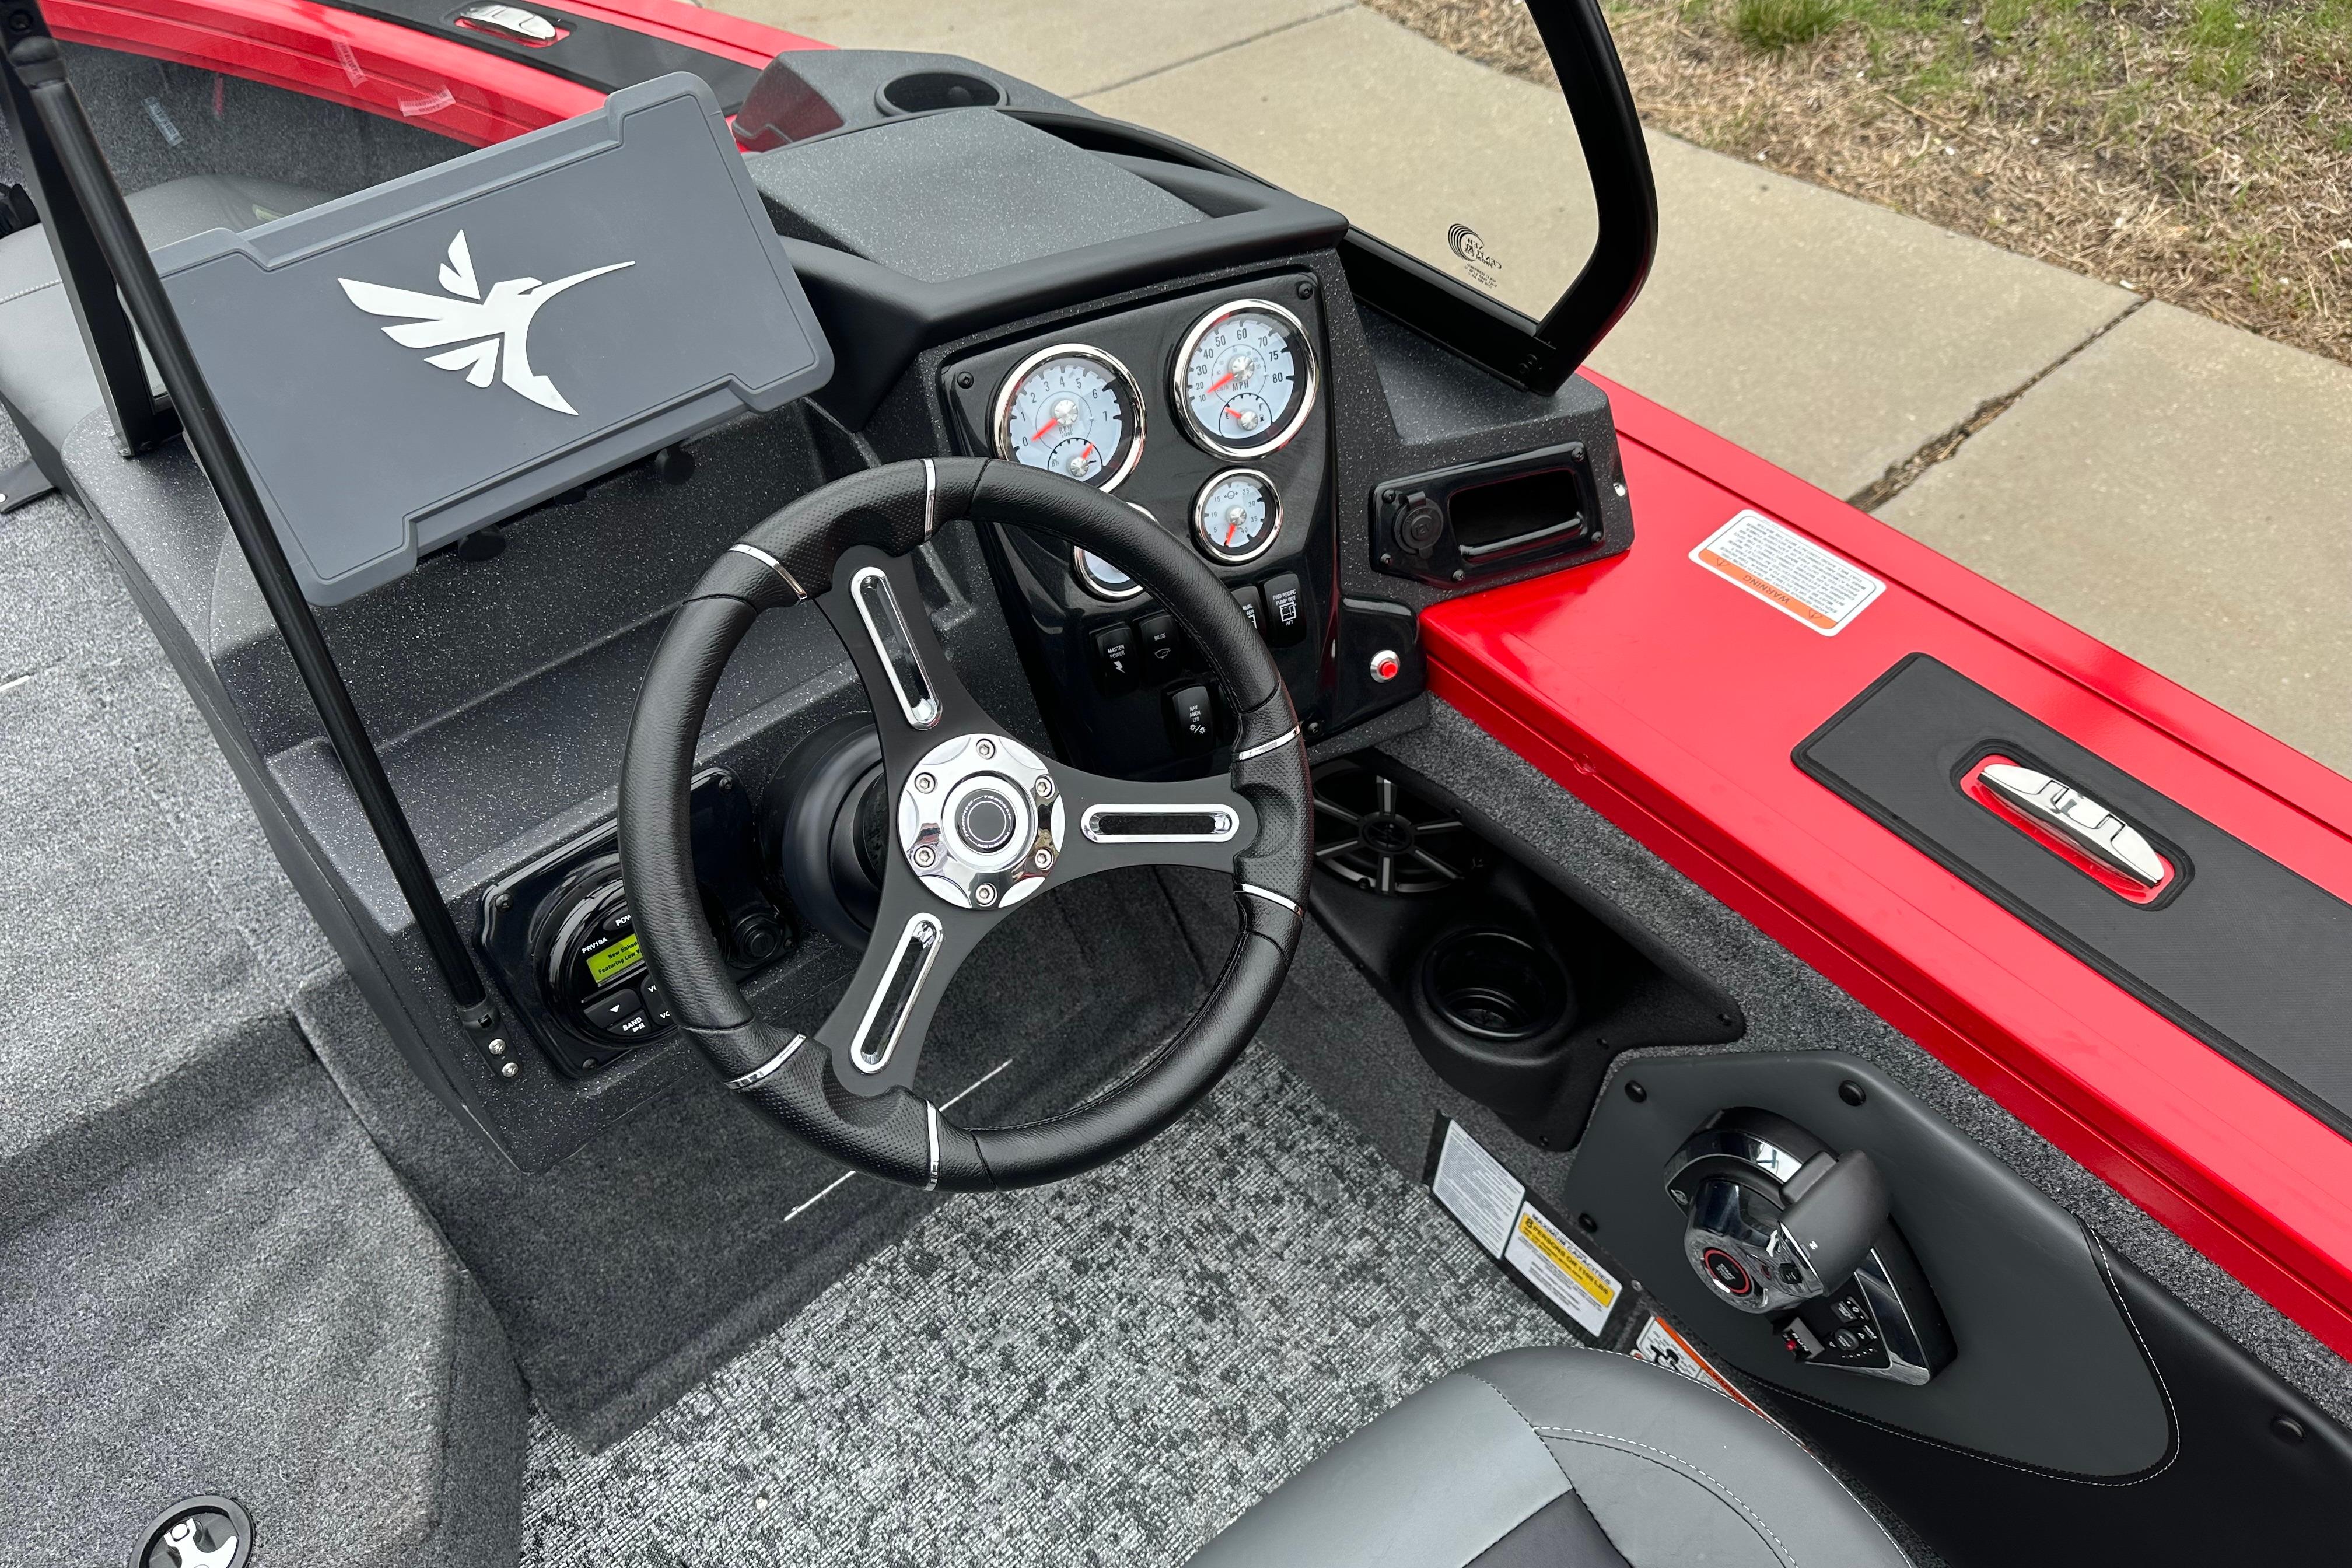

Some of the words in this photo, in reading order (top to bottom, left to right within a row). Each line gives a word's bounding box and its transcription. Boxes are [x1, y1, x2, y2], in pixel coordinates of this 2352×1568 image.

[1237, 328, 1247, 340] 60
[1215, 335, 1226, 347] 50
[1258, 335, 1268, 348] 70
[1203, 348, 1213, 359] 40
[1269, 350, 1279, 362] 75
[1196, 365, 1208, 376] 30
[1060, 376, 1065, 387] 4
[1076, 378, 1082, 388] 5
[1272, 372, 1283, 383] 80
[1044, 380, 1050, 392] 3
[1196, 382, 1204, 390] 20
[1232, 380, 1249, 391] MPH
[1030, 392, 1037, 403] 2
[1092, 388, 1098, 399] 6
[1199, 394, 1206, 402] 10
[1021, 411, 1026, 422] 1
[1102, 411, 1107, 421] 7
[1059, 424, 1073, 434] RPM
[1022, 436, 1028, 447] 0
[1741, 574, 1791, 603] WARNING
[1154, 632, 1166, 641] BILGE
[1107, 644, 1125, 653] MASTER
[1110, 650, 1125, 659] POWER
[608, 951, 620, 960] New
[598, 958, 625, 974] Featuring
[624, 952, 635, 961] Low
[622, 1017, 642, 1031] BAND
[1532, 1225, 1566, 1257] PERSONS
[1531, 1212, 1566, 1246] MAXIMUM
[1566, 1244, 1611, 1286] CAPACITIES
